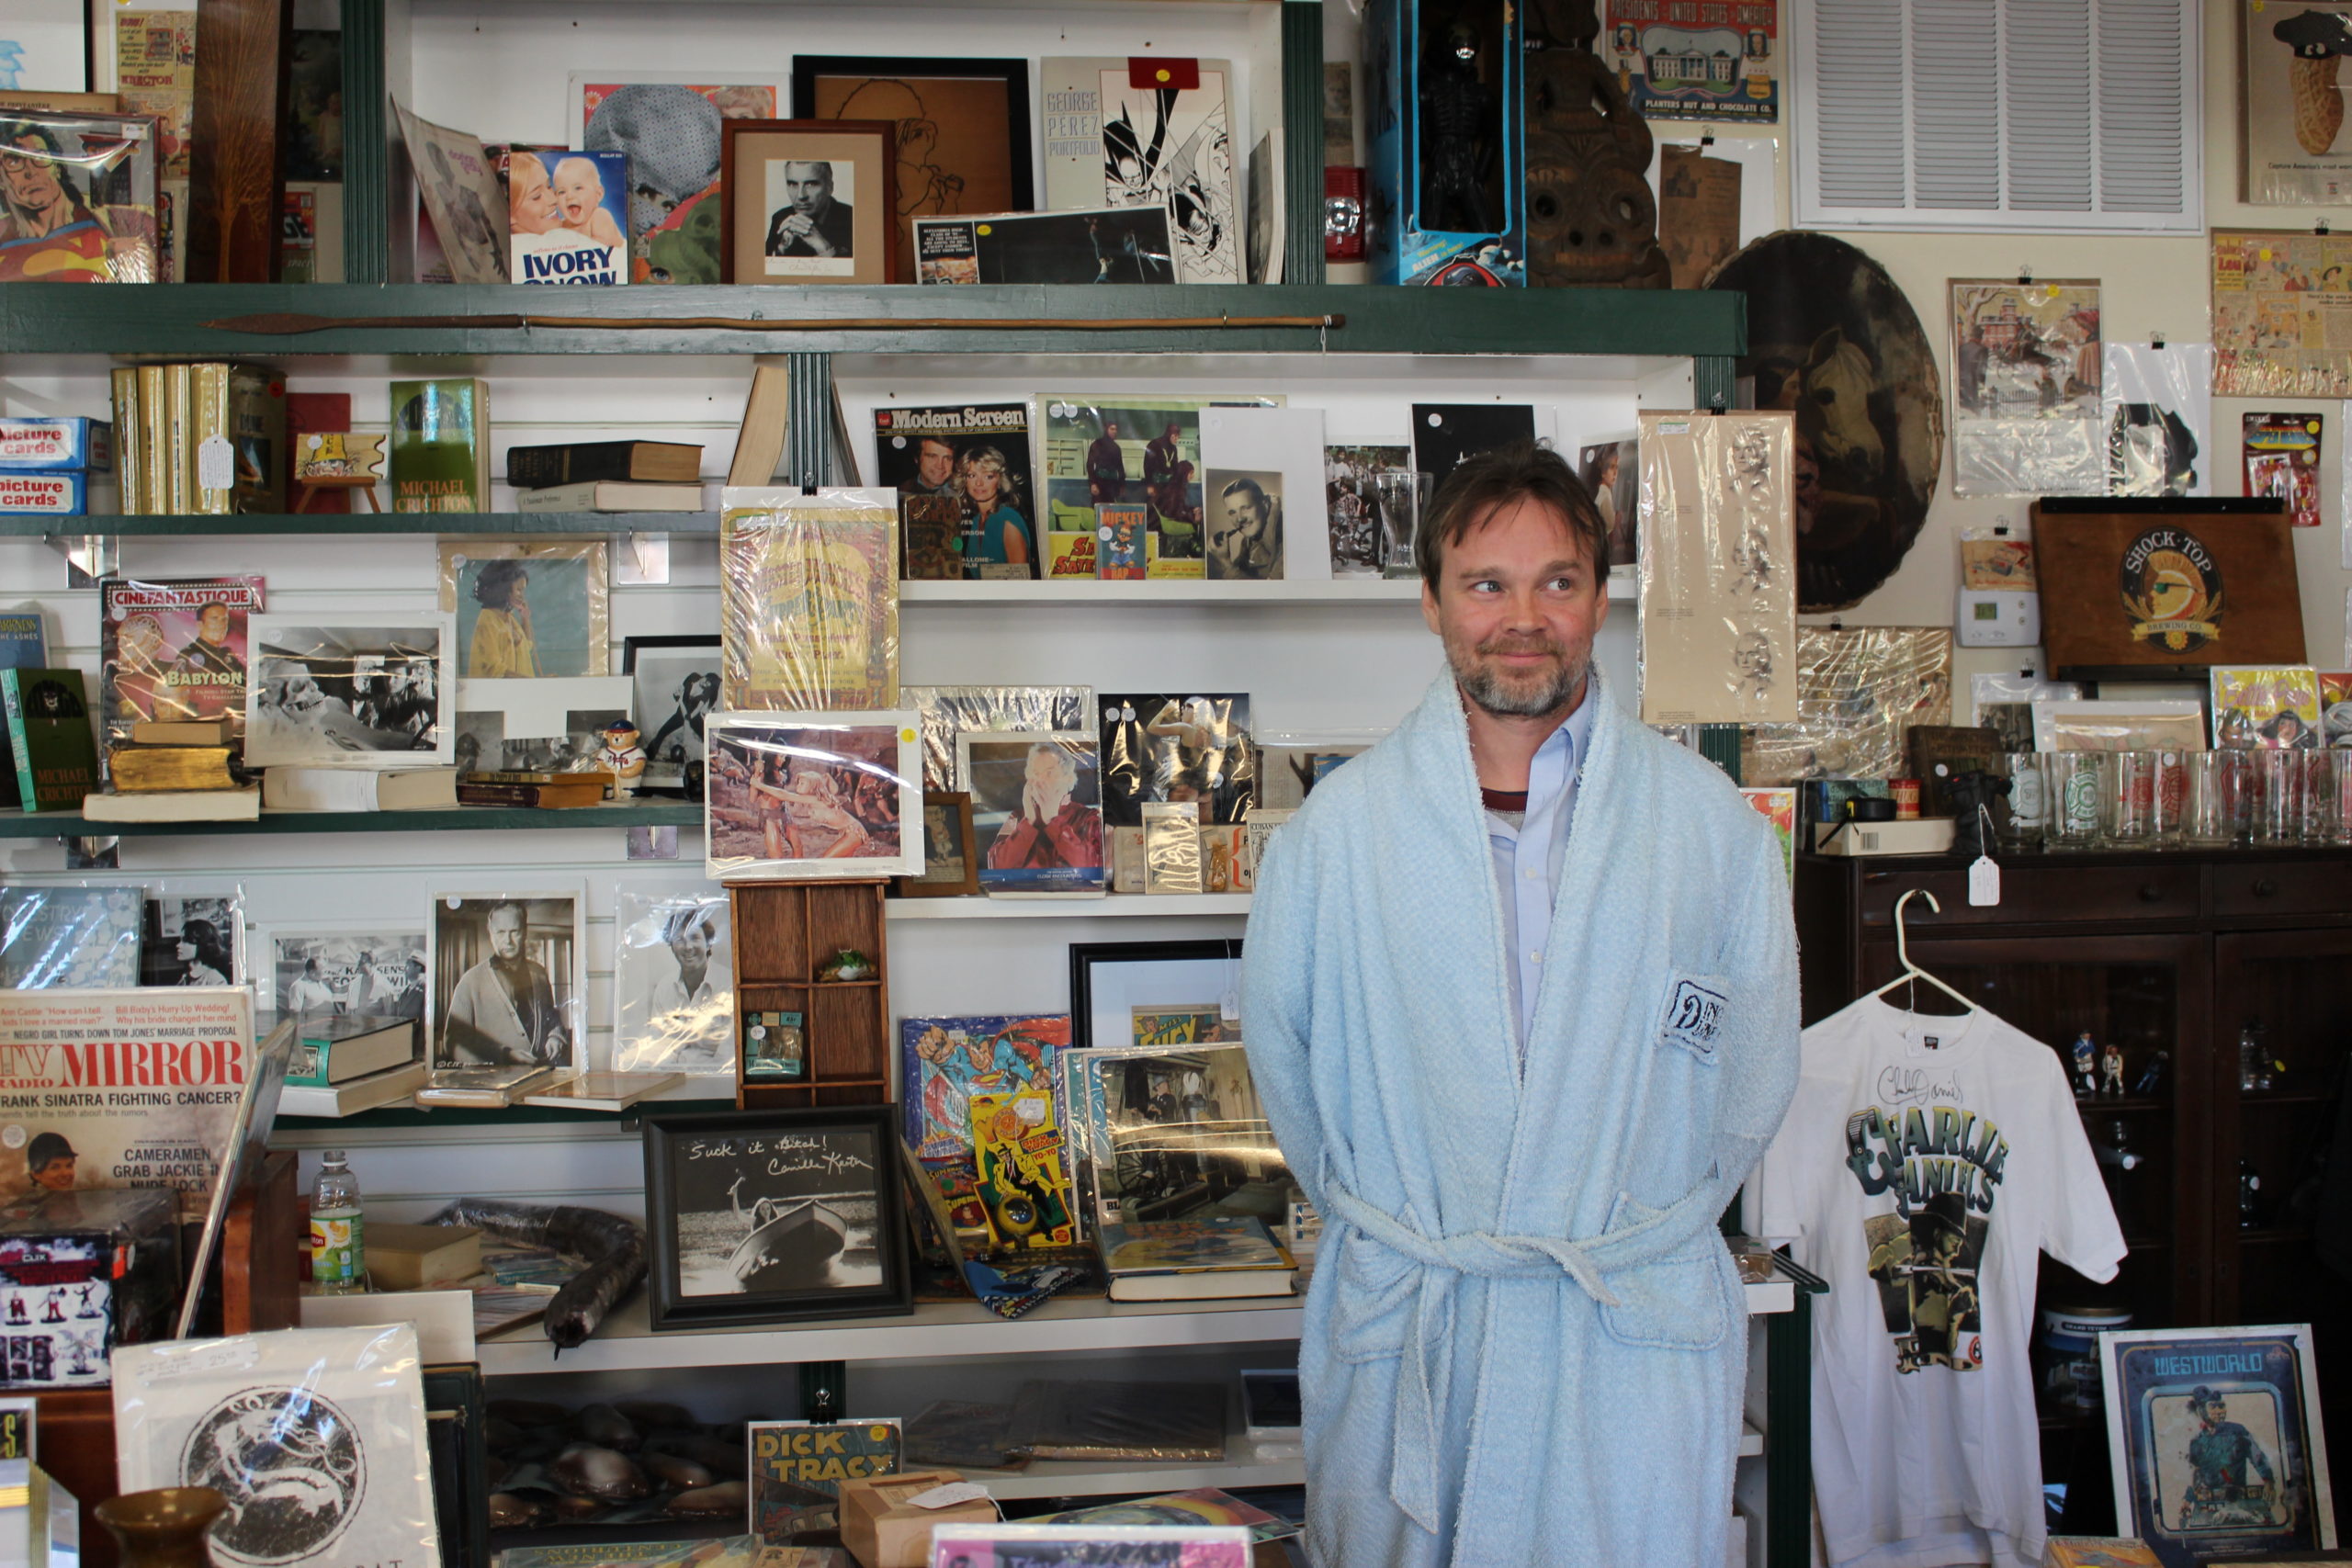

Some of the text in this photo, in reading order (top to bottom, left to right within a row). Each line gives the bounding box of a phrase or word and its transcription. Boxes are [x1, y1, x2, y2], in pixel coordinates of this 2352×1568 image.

[1670, 3, 1697, 22] UNITED
[1702, 4, 1727, 24] STATES
[1737, 6, 1772, 26] AMERICA
[1047, 91, 1097, 111] GEORGE
[1645, 99, 1679, 109] PLANTERS
[1683, 101, 1698, 109] NUT
[1702, 102, 1715, 110] AND
[1719, 102, 1757, 112] CHOCOLATE
[1048, 116, 1099, 137] PEREZ
[1049, 140, 1100, 156] PORTFOLIO
[523, 246, 614, 278] IVORY
[1411, 254, 1440, 272] ALIEN
[891, 407, 1024, 429] Modern Screen
[5, 442, 56, 454] cards
[400, 479, 467, 496] MICHAEL
[3, 493, 57, 505] cards
[396, 495, 470, 513] CRICHTON
[1101, 512, 1145, 525] MICKEY
[2125, 531, 2211, 573] SHOCK TOP
[115, 590, 249, 605] CINEFANTASTIQUE
[2148, 622, 2187, 632] BREWING
[166, 671, 243, 686] BABYLON
[37, 768, 89, 784] MICHAEL
[117, 1016, 132, 1025] Why
[147, 1015, 165, 1023] bride
[169, 1014, 200, 1024] changed
[14, 1031, 40, 1040] NEGRO
[42, 1030, 58, 1039] GIRL
[60, 1030, 85, 1039] TURNS
[87, 1029, 110, 1038] DOWN
[113, 1029, 128, 1038] TOM
[157, 1028, 196, 1037] MARRIAGE
[198, 1027, 237, 1036] PROPOSAL
[58, 1040, 245, 1088] MIRROR
[0, 1090, 241, 1108] RANK SINATRA FIGHTING CANCER?
[41, 1110, 54, 1118] the
[58, 1109, 76, 1117] truth
[79, 1109, 101, 1118] about
[106, 1109, 118, 1117] the
[124, 1148, 211, 1162] CAMERAMEN
[690, 1145, 736, 1159] Suck
[749, 1142, 764, 1154] it
[1034, 1148, 1057, 1160] YO-YO
[1846, 1105, 2009, 1196] CHARLIE
[113, 1165, 151, 1178] GRAB
[156, 1164, 204, 1177] JACKIE
[22, 1253, 47, 1263] CLIX
[2154, 1352, 2262, 1376] WESTWORLD
[756, 1432, 846, 1459] DICK
[771, 1454, 892, 1483] TRACY
